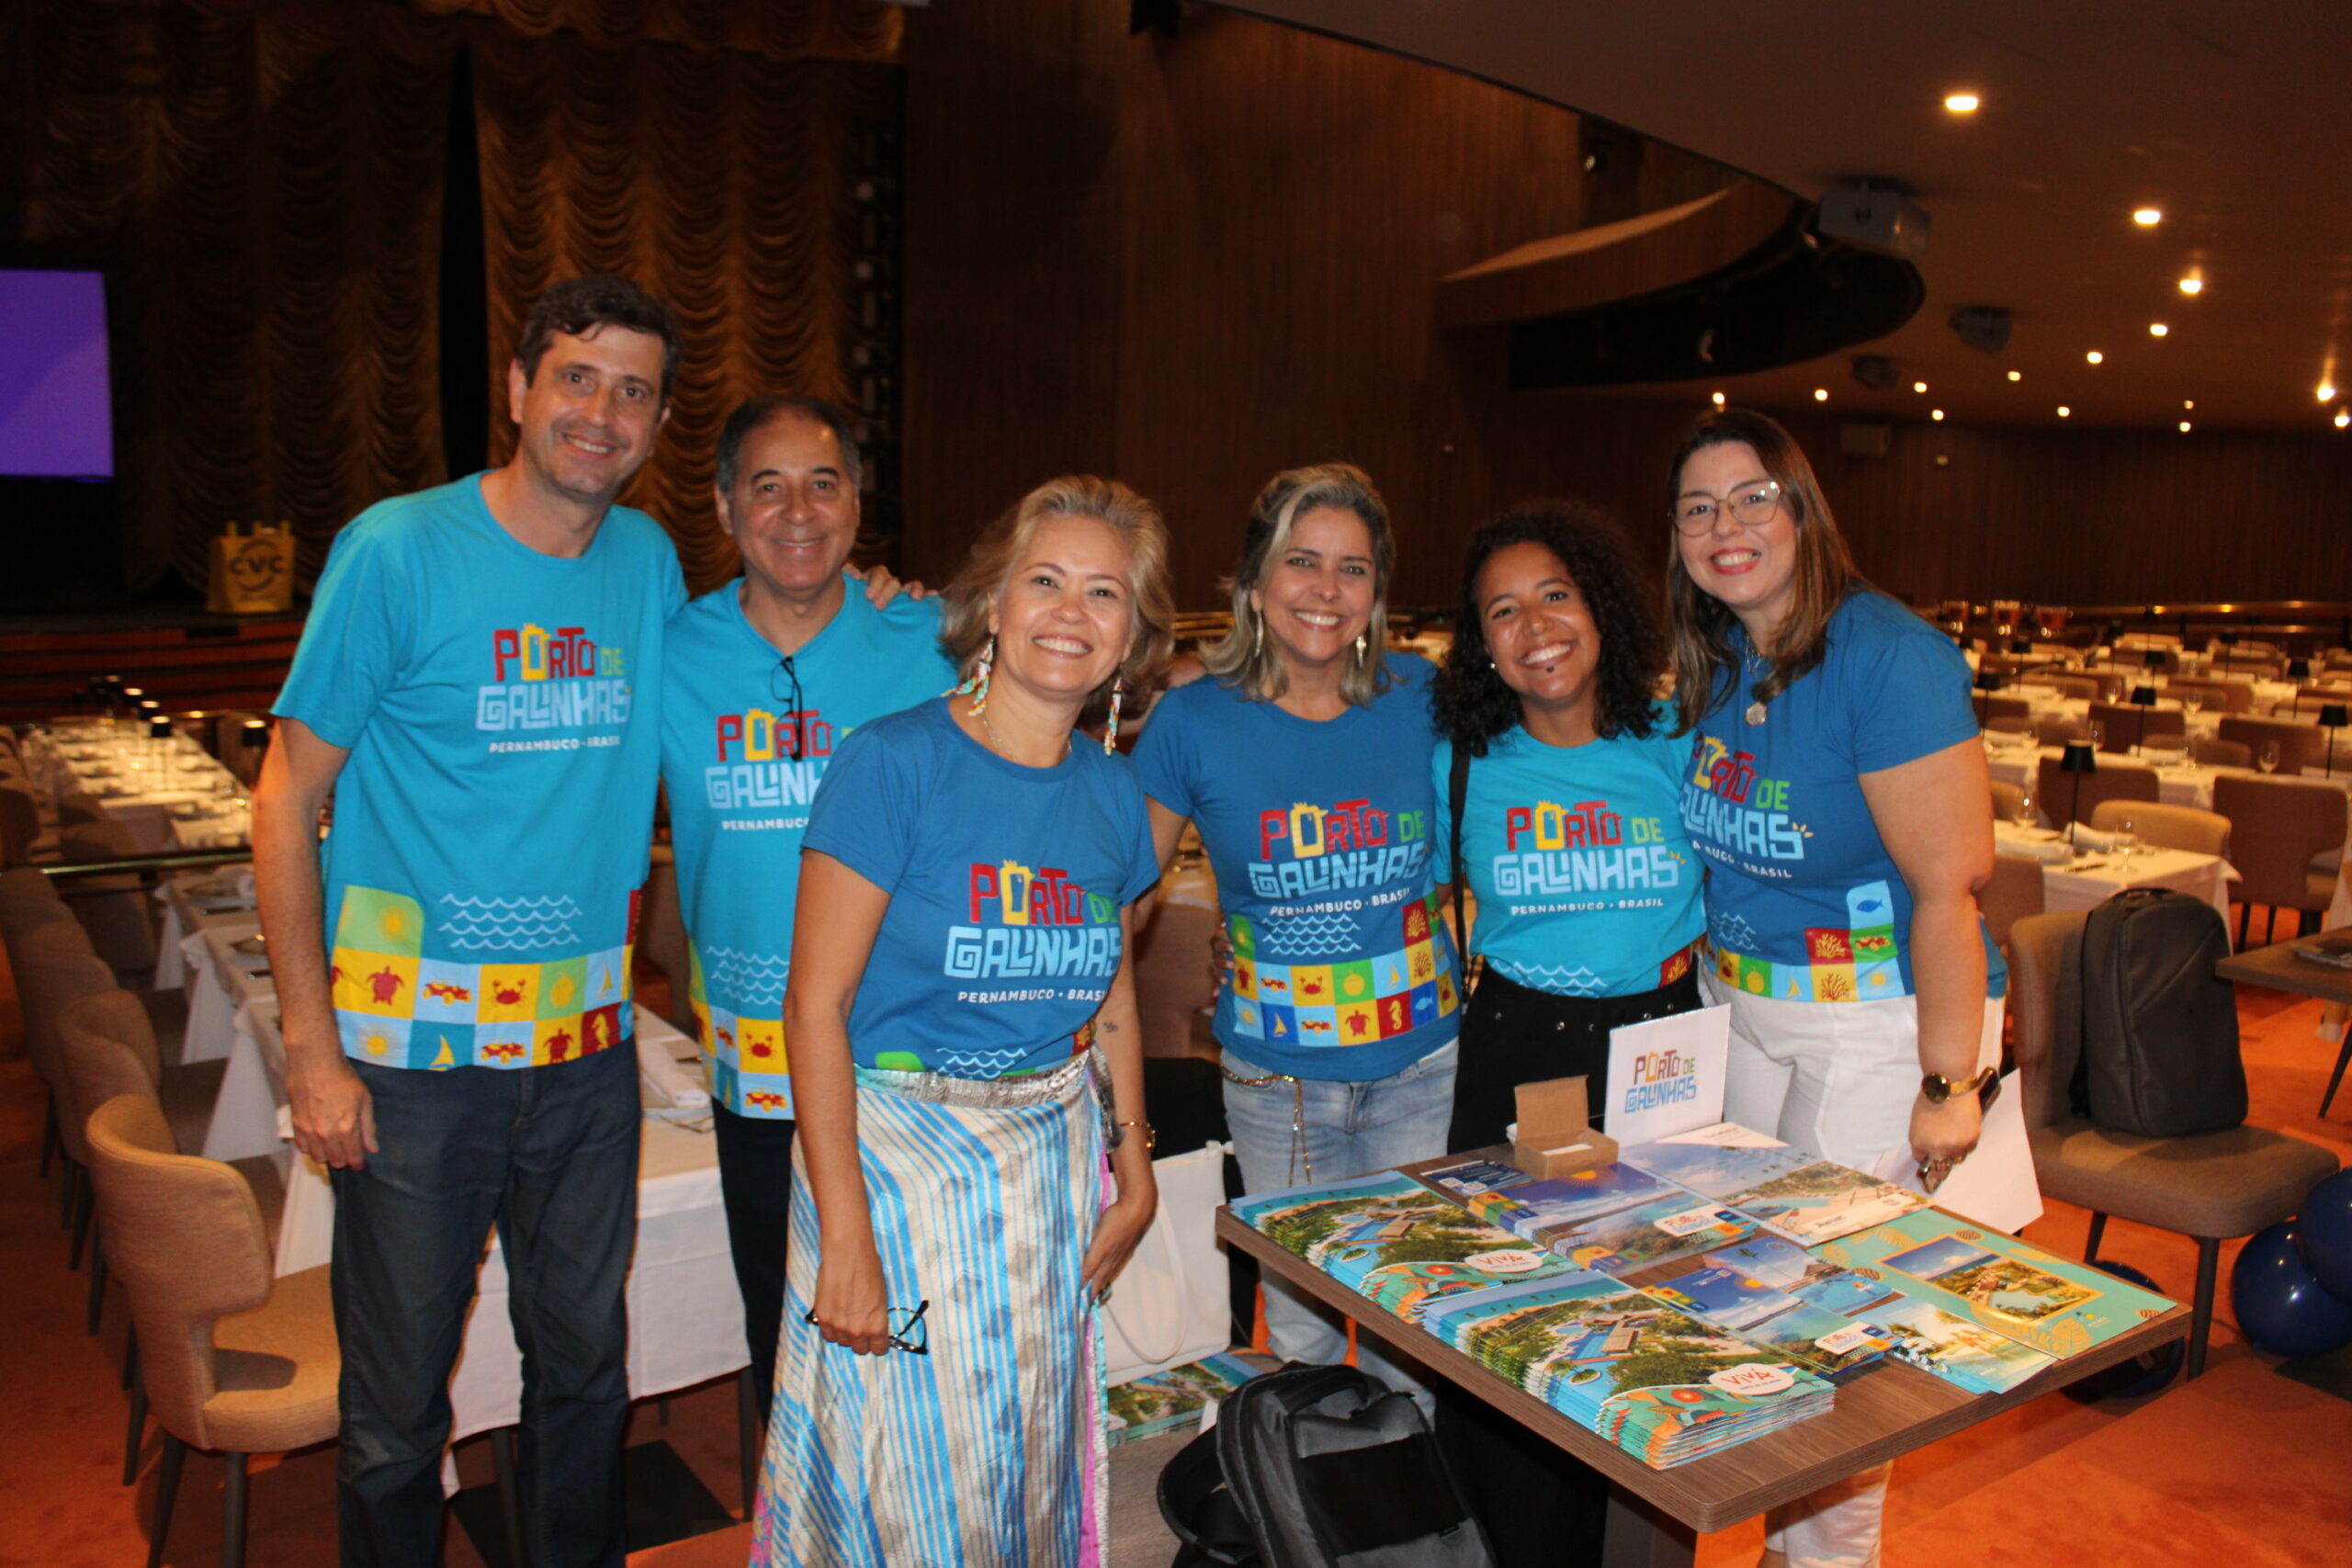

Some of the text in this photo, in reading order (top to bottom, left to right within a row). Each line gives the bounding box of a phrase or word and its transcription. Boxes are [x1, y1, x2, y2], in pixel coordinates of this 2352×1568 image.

[228, 555, 283, 576] CVC
[493, 623, 625, 682] PORTO DE
[476, 680, 630, 731] GALINHAS
[488, 738, 580, 754] PERNAMBUCO
[717, 708, 834, 762] PORTO
[1755, 779, 1791, 810] DE
[1260, 798, 1424, 861] PORTO DE
[1506, 800, 1665, 852] PORTO DE
[1679, 782, 1804, 860] ALINHAS
[969, 860, 1086, 926] PORTO
[1248, 840, 1425, 898] GALINHAS
[1493, 845, 1679, 896] GALINHAS
[1743, 862, 1792, 879] BRASIL
[1270, 899, 1362, 917] PERNAMBUCO
[1510, 898, 1664, 916] PERNAMBUCO BRASIL
[944, 926, 1122, 978] GALINHAS
[957, 989, 1055, 1003] PERNAMBUCO
[1634, 1049, 1696, 1086] PORTO DE
[1623, 1076, 1698, 1114] GALINHAS
